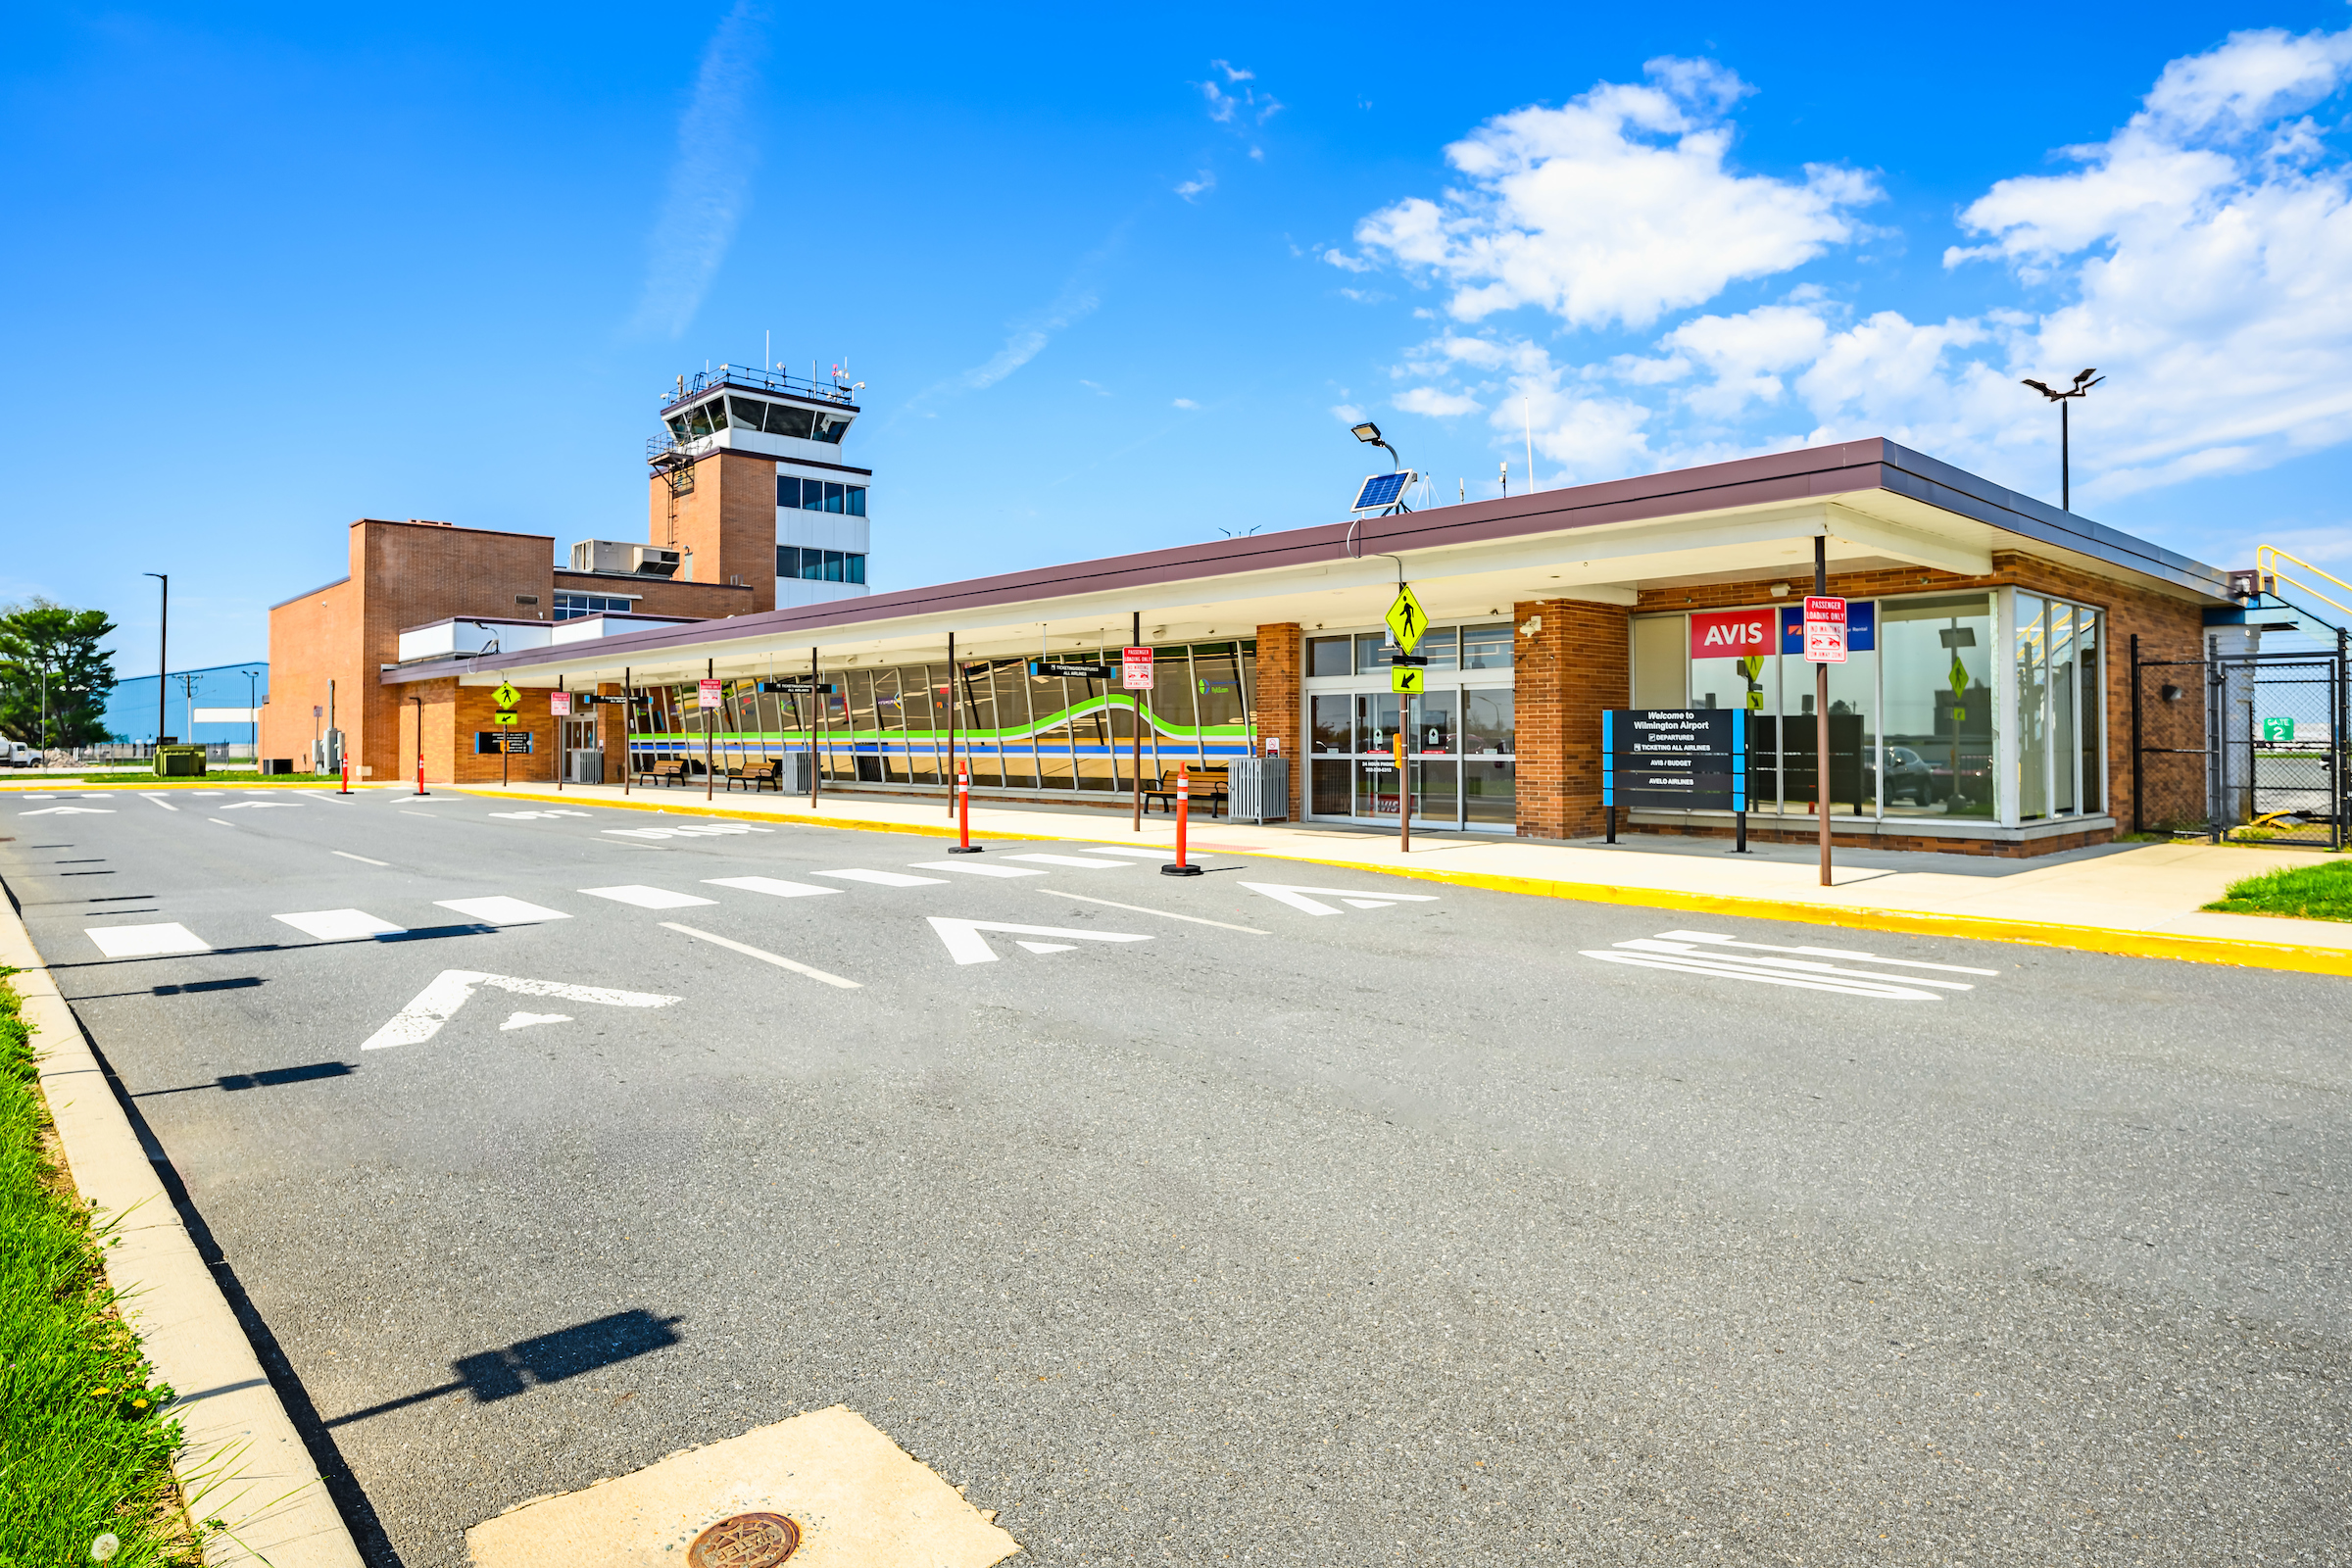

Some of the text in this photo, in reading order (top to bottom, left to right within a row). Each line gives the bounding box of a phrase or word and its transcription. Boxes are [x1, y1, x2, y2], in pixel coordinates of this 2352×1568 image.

[1811, 600, 1841, 610] PASSENGER
[1806, 611, 1844, 621] LOADING ONLY
[1703, 622, 1763, 647] AVIS
[1819, 625, 1841, 634] WAITING
[1648, 711, 1694, 720] Welcome to
[1634, 721, 1710, 731] Wilmington Airport
[2273, 726, 2285, 740] 2
